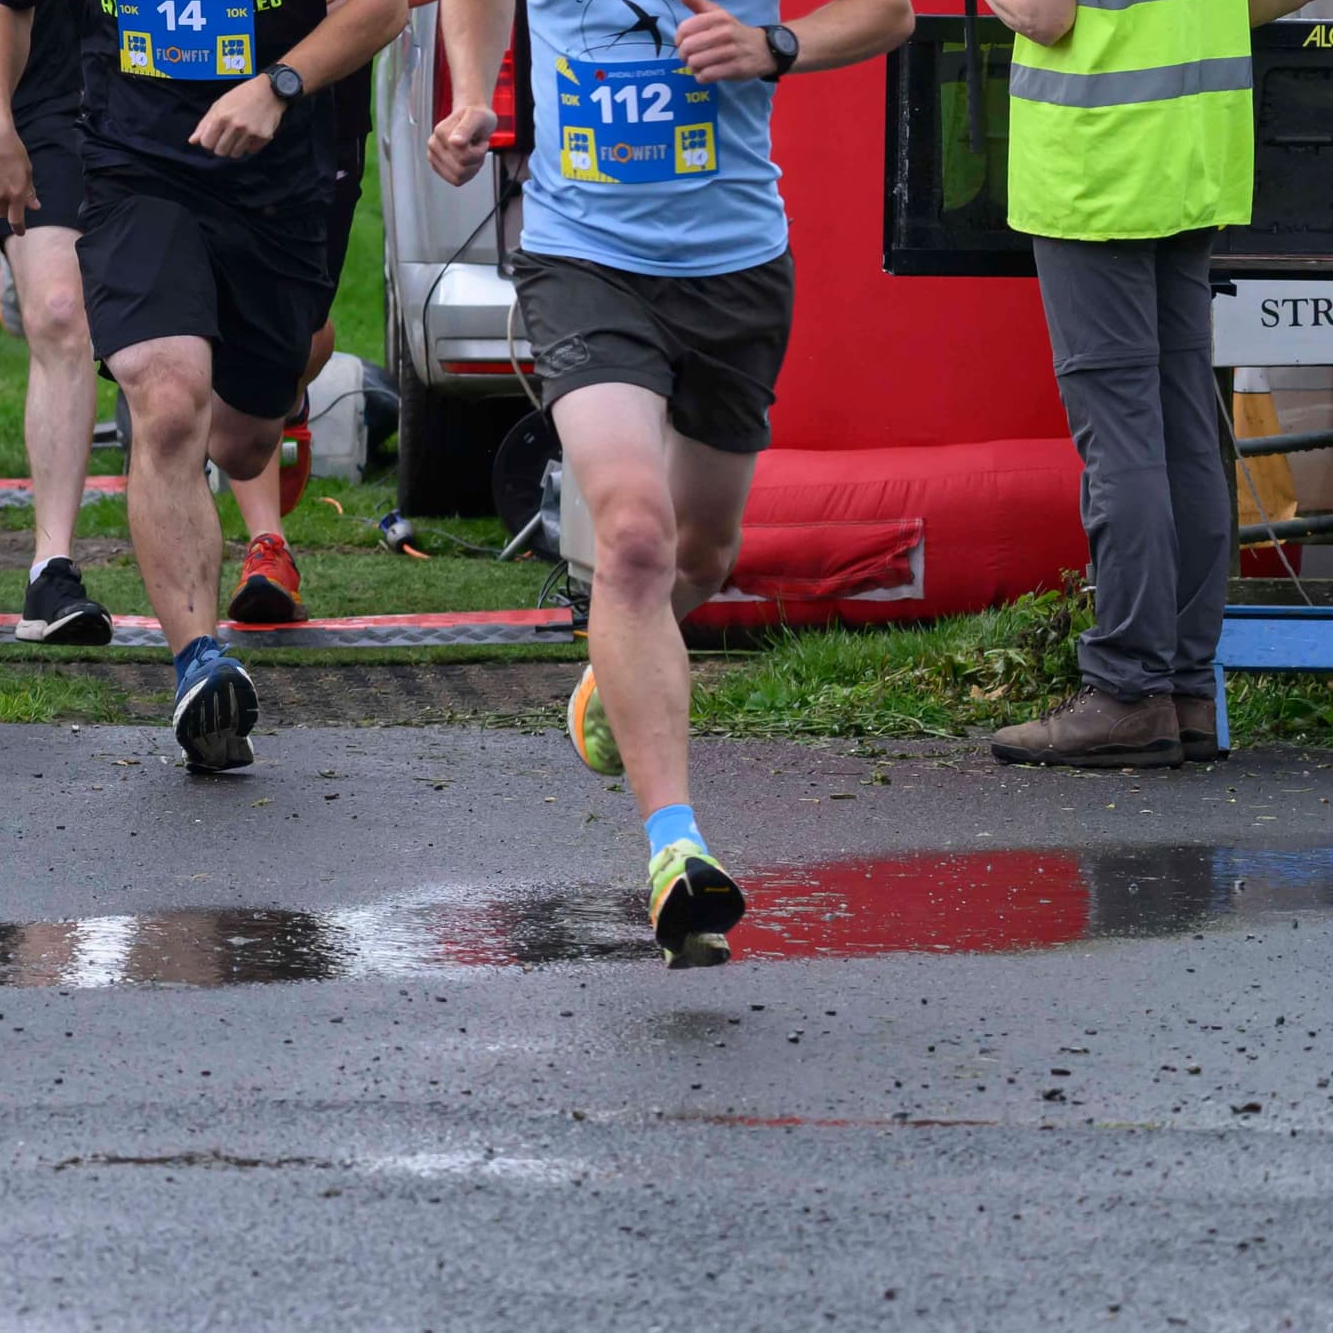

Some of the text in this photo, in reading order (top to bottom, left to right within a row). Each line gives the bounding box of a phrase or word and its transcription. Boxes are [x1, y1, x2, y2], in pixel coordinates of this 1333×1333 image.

[119, 4, 139, 16] 10K
[156, 0, 206, 31] 14
[226, 7, 248, 18] 10K
[156, 46, 210, 63] FLOWFIT
[560, 93, 580, 106] 10K
[590, 82, 674, 124] 112
[685, 91, 710, 104] 10K
[600, 142, 667, 164] FLOWFIT
